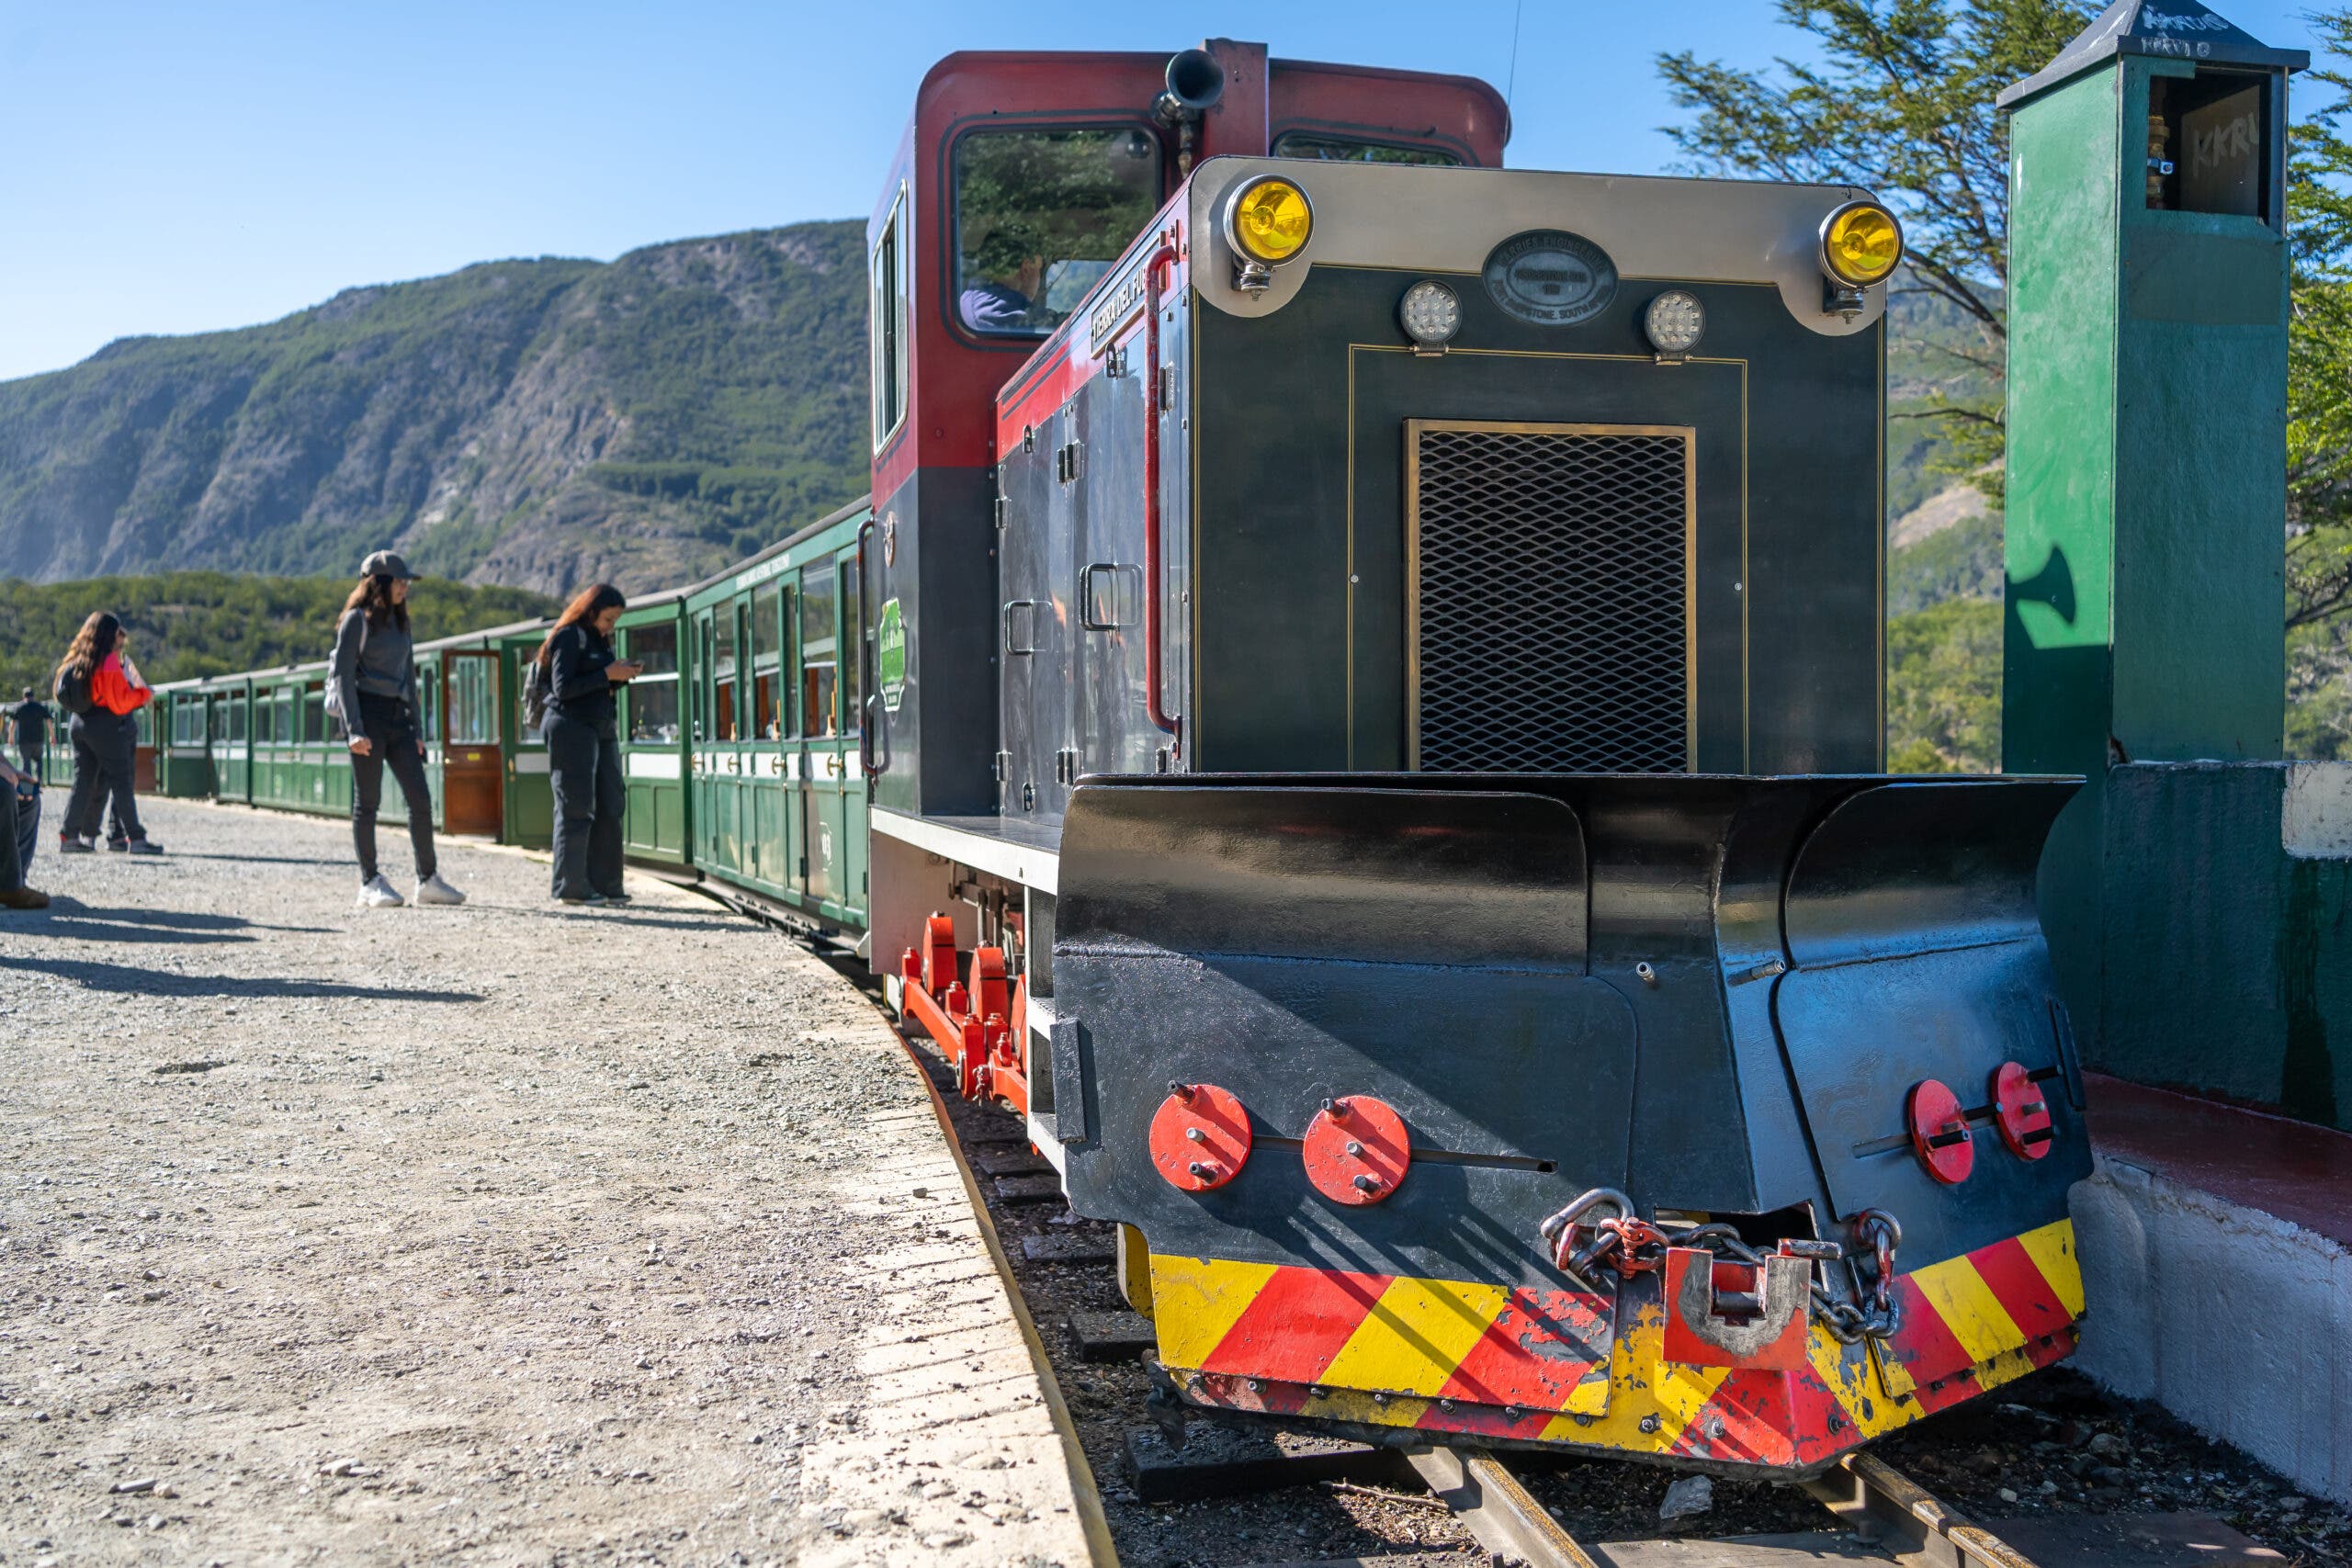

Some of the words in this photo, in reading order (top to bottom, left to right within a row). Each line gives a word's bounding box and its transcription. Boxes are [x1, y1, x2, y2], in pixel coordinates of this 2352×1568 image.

[1092, 296, 1116, 342] TIERRA
[1116, 282, 1132, 318] DEL
[1133, 266, 1146, 301] FUE
[1559, 304, 1589, 320] SOUTH
